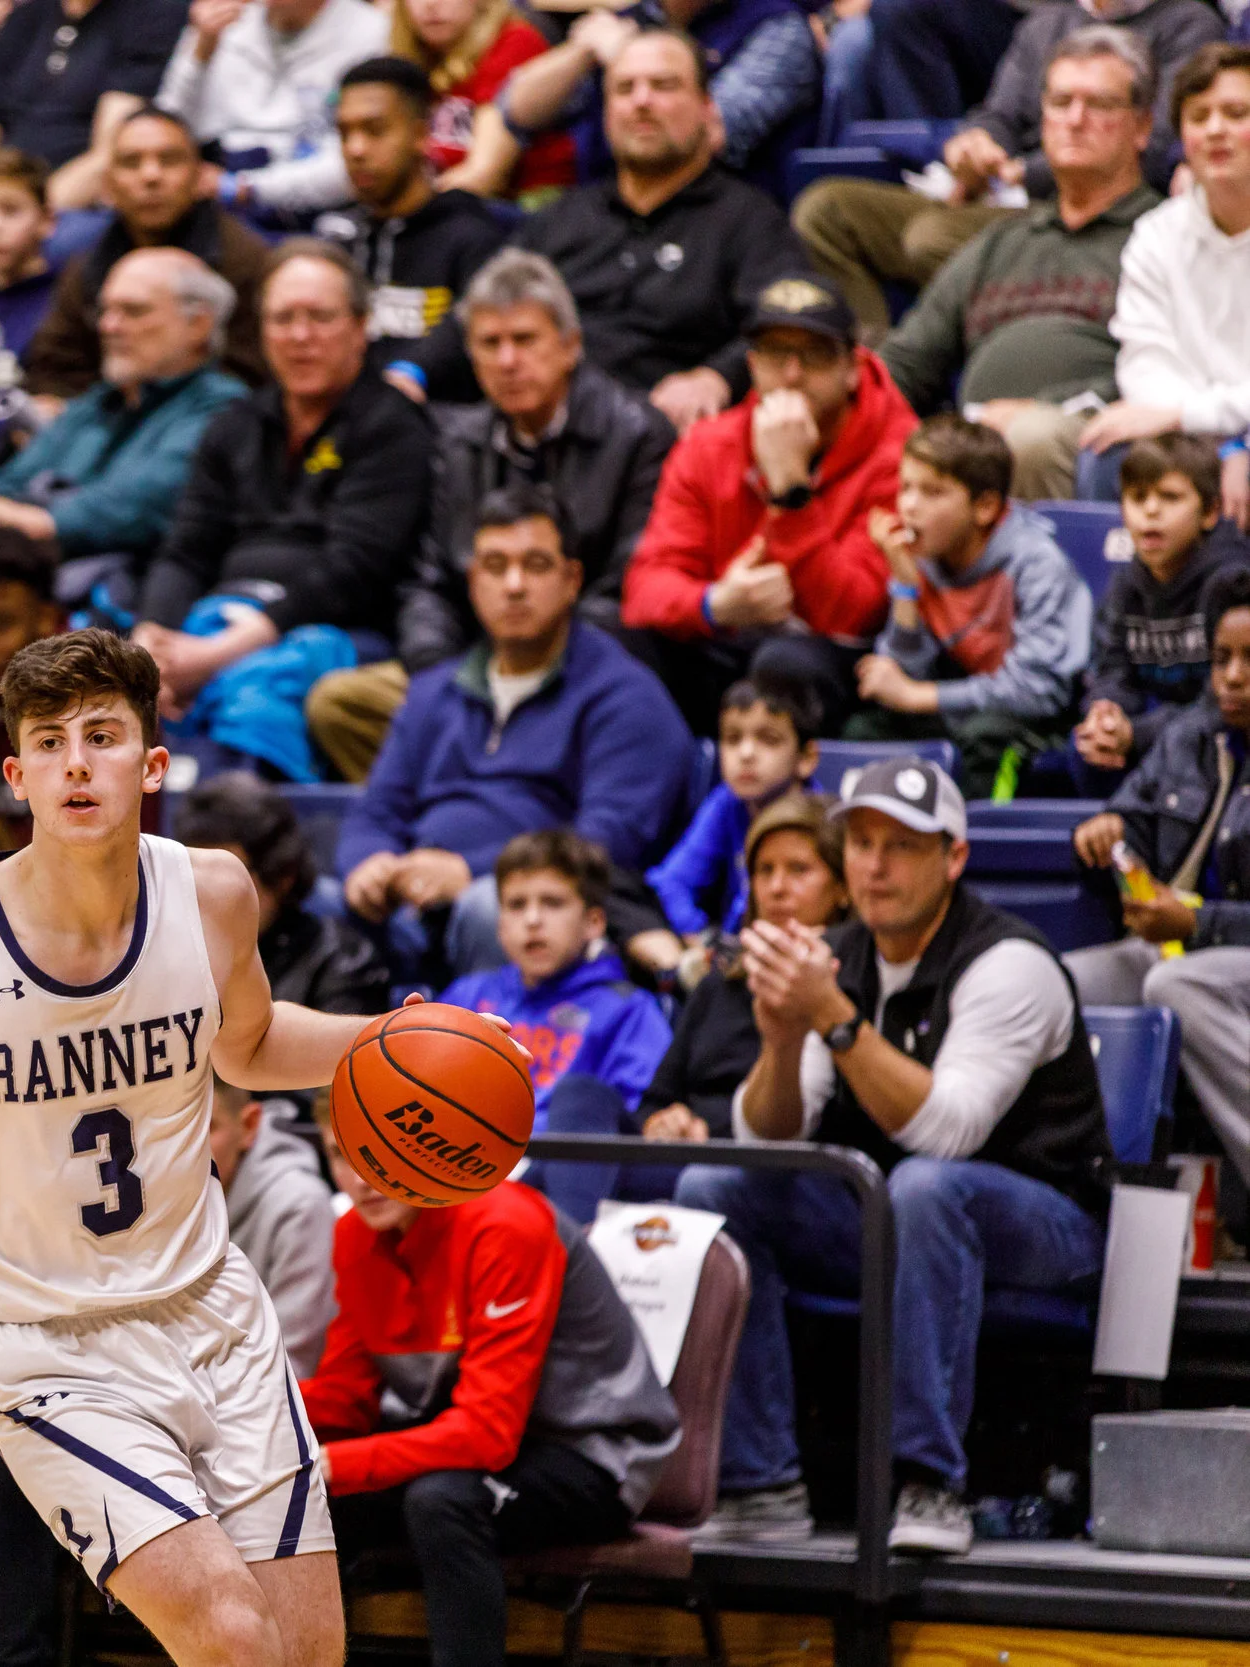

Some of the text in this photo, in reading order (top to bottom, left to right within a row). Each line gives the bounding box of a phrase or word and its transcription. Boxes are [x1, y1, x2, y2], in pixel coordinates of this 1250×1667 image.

[69, 1104, 146, 1240] 3
[357, 1144, 452, 1206] ELITE
[383, 1100, 498, 1180] Baden
[398, 1137, 469, 1181] PERFECTION
